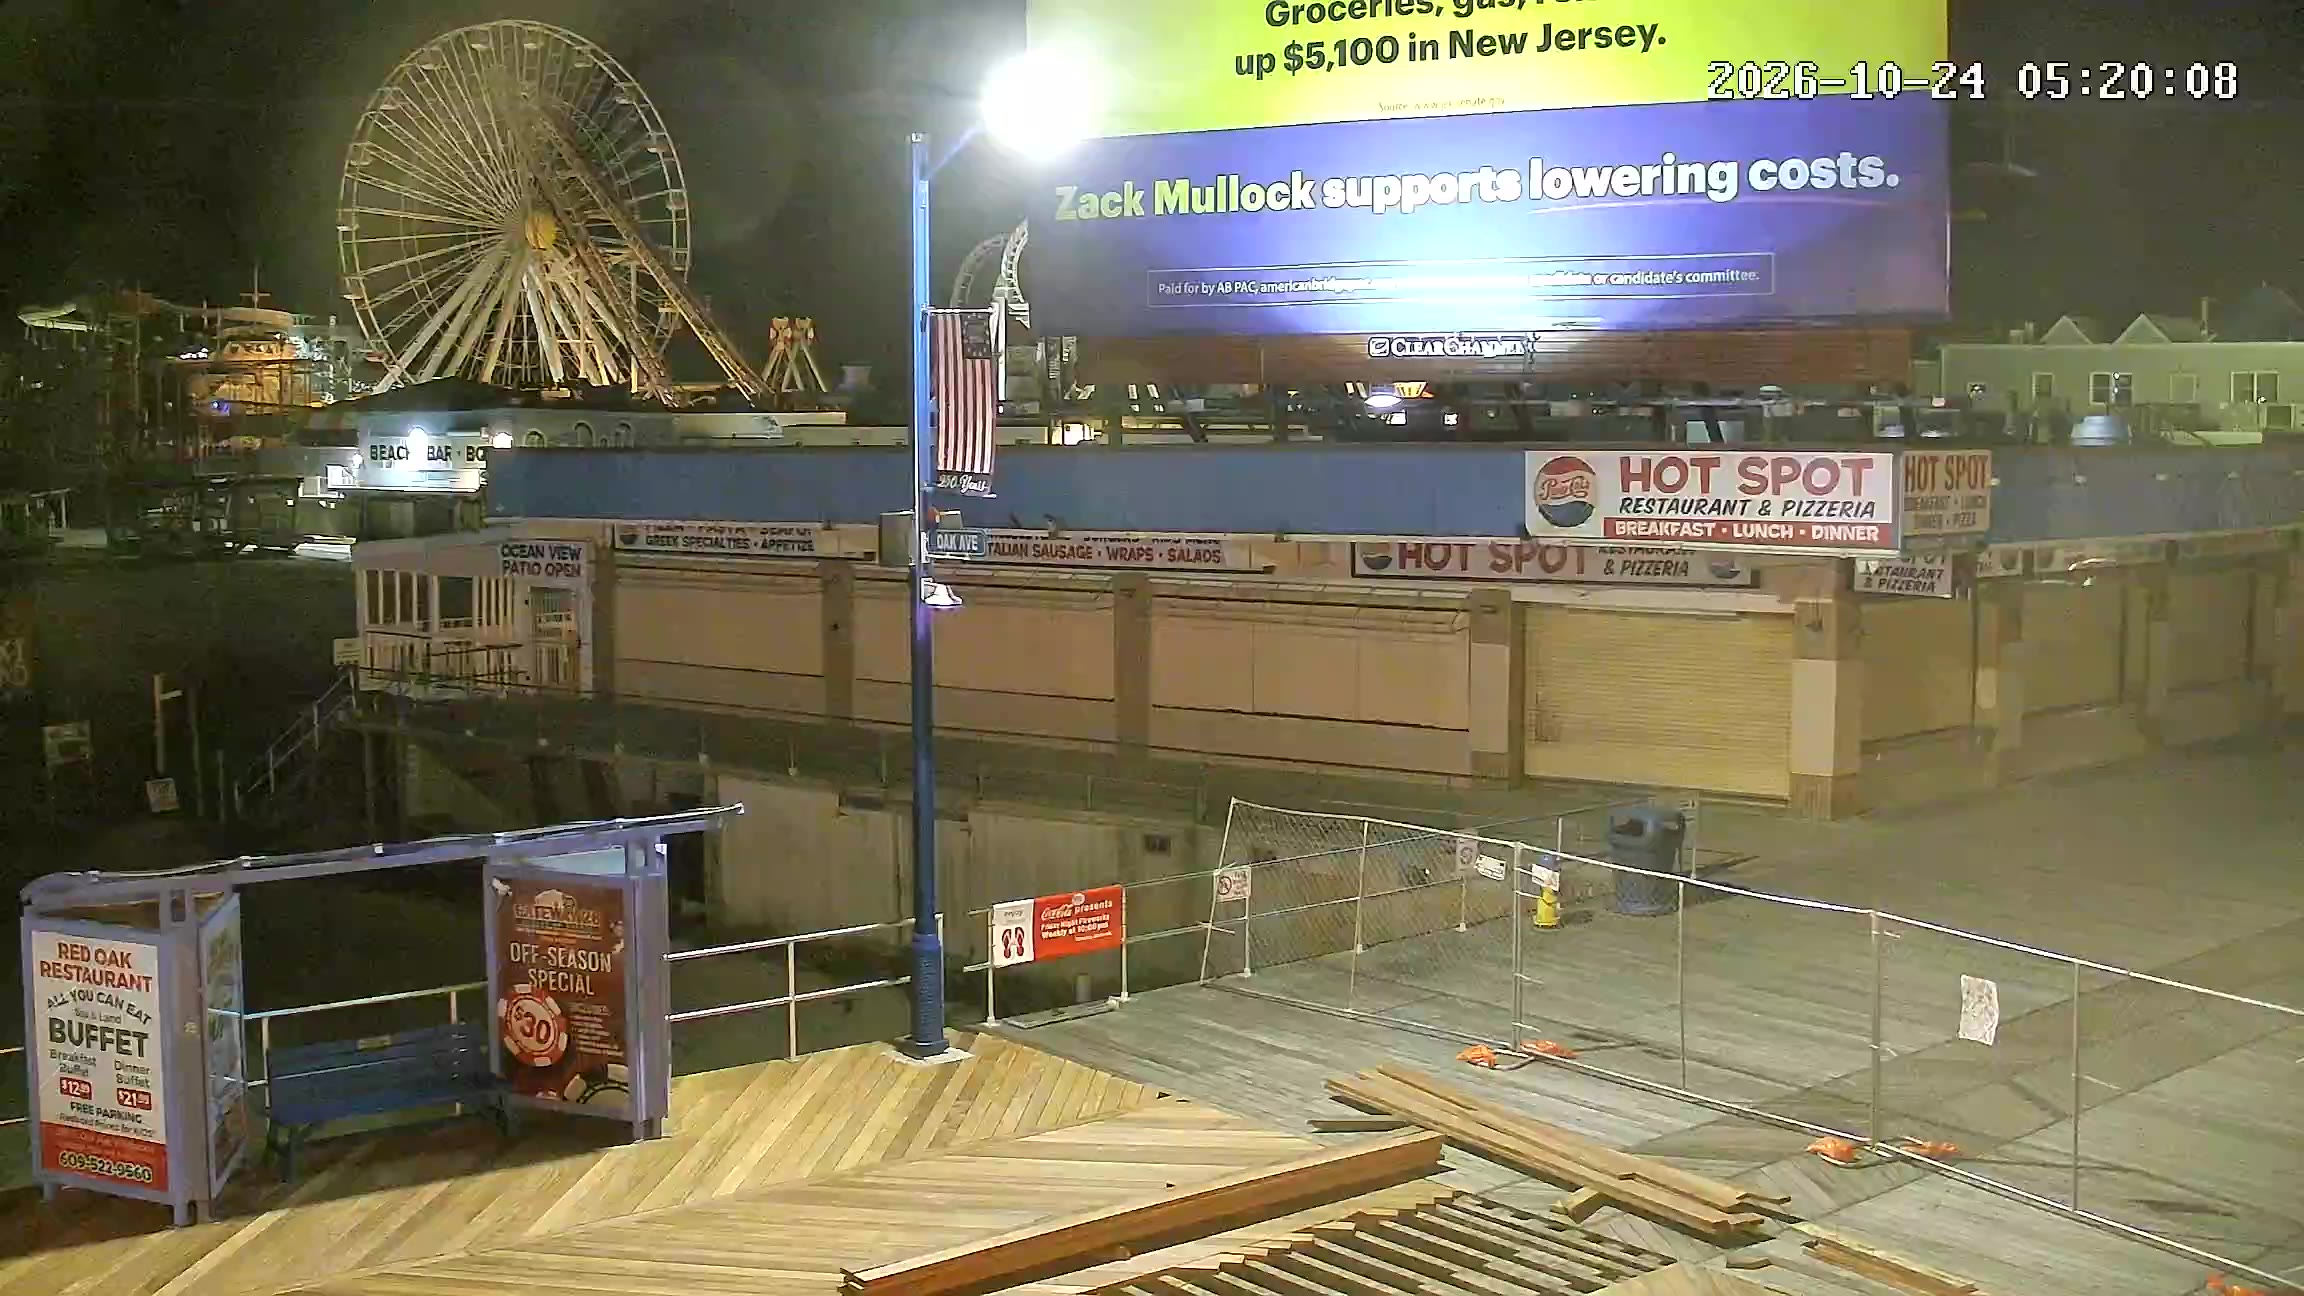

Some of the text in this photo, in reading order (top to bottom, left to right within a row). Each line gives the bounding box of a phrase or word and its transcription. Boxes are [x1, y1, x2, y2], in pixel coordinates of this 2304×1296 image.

[1265, 0, 1443, 28] Groceries,
[1235, 23, 1667, 80] up $5,100 in New Jersey.
[1055, 152, 1901, 221] Zack Mullock supports lowering costs.
[1158, 283, 1182, 295] Paid
[1184, 282, 1200, 294] for
[1201, 282, 1216, 296] by
[1217, 281, 1233, 293] AB
[1234, 281, 1258, 295] PAC,
[1609, 271, 1683, 286] candidate's
[1685, 270, 1761, 284] committee.
[427, 445, 452, 461] BAR
[1619, 456, 1874, 497] HOT SPOT
[1904, 455, 1989, 493] HOT SPOT
[1619, 496, 1876, 519] RESTAURANT & PIZZERIA
[681, 535, 750, 551] SPECIALTIES
[936, 534, 957, 551] OAK
[958, 535, 979, 551] AVE
[1615, 520, 1880, 542] BREAKFAST LUNCH DINNER
[501, 543, 582, 561] OCEAN VIEW
[987, 542, 1222, 564] TALIAN SAUSAGE WRAPS SALADS
[1398, 540, 1585, 575] HOT SPOT
[502, 559, 582, 579] PATIO OPEN
[1603, 558, 1689, 577] & PIZZERIA
[1877, 577, 1937, 593] PIZZERIA
[1074, 900, 1113, 915] presents
[57, 942, 132, 969] RED OAK
[510, 941, 613, 974] OFF-SEASON
[39, 960, 153, 993] RESTAURANT
[527, 968, 596, 997] SPECIAL
[48, 988, 152, 1025] ALL YOU CAN EAT
[513, 1004, 552, 1046] $30
[48, 1017, 150, 1058] BUFFET
[114, 1059, 151, 1075] Dinner
[115, 1072, 151, 1089] Buffet
[118, 1089, 151, 1107] $21
[70, 1101, 142, 1124] FREE PARKING
[59, 1150, 153, 1184] 609-522-9560
